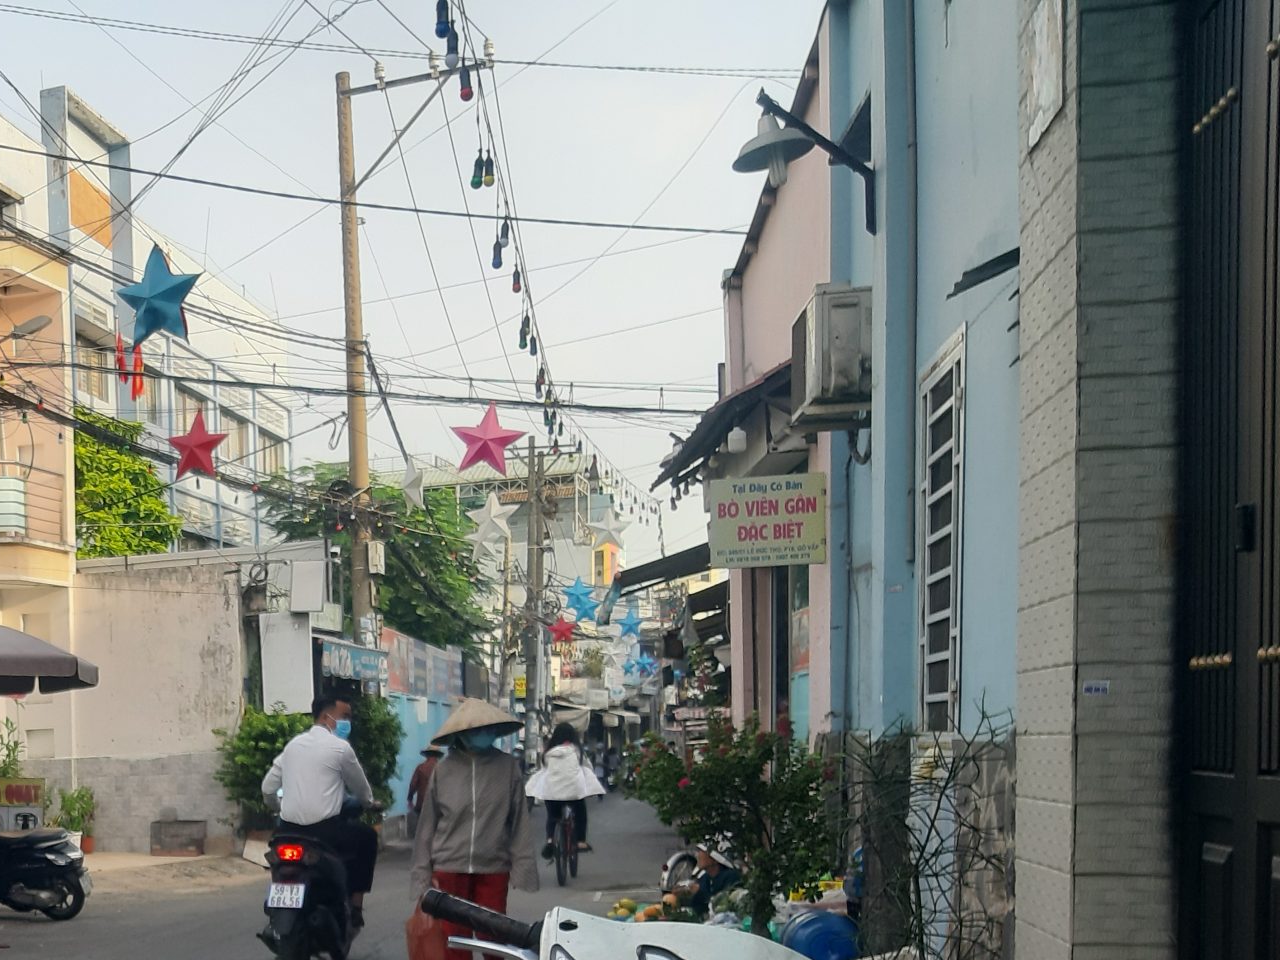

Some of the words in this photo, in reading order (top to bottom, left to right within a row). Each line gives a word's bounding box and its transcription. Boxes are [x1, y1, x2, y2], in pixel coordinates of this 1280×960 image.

[770, 481, 782, 491] Có
[785, 480, 803, 490] Bán
[745, 496, 778, 518] VIÊN
[784, 493, 817, 515] GÂN
[737, 522, 768, 545] ĐẶC
[773, 519, 804, 543] BIỆT
